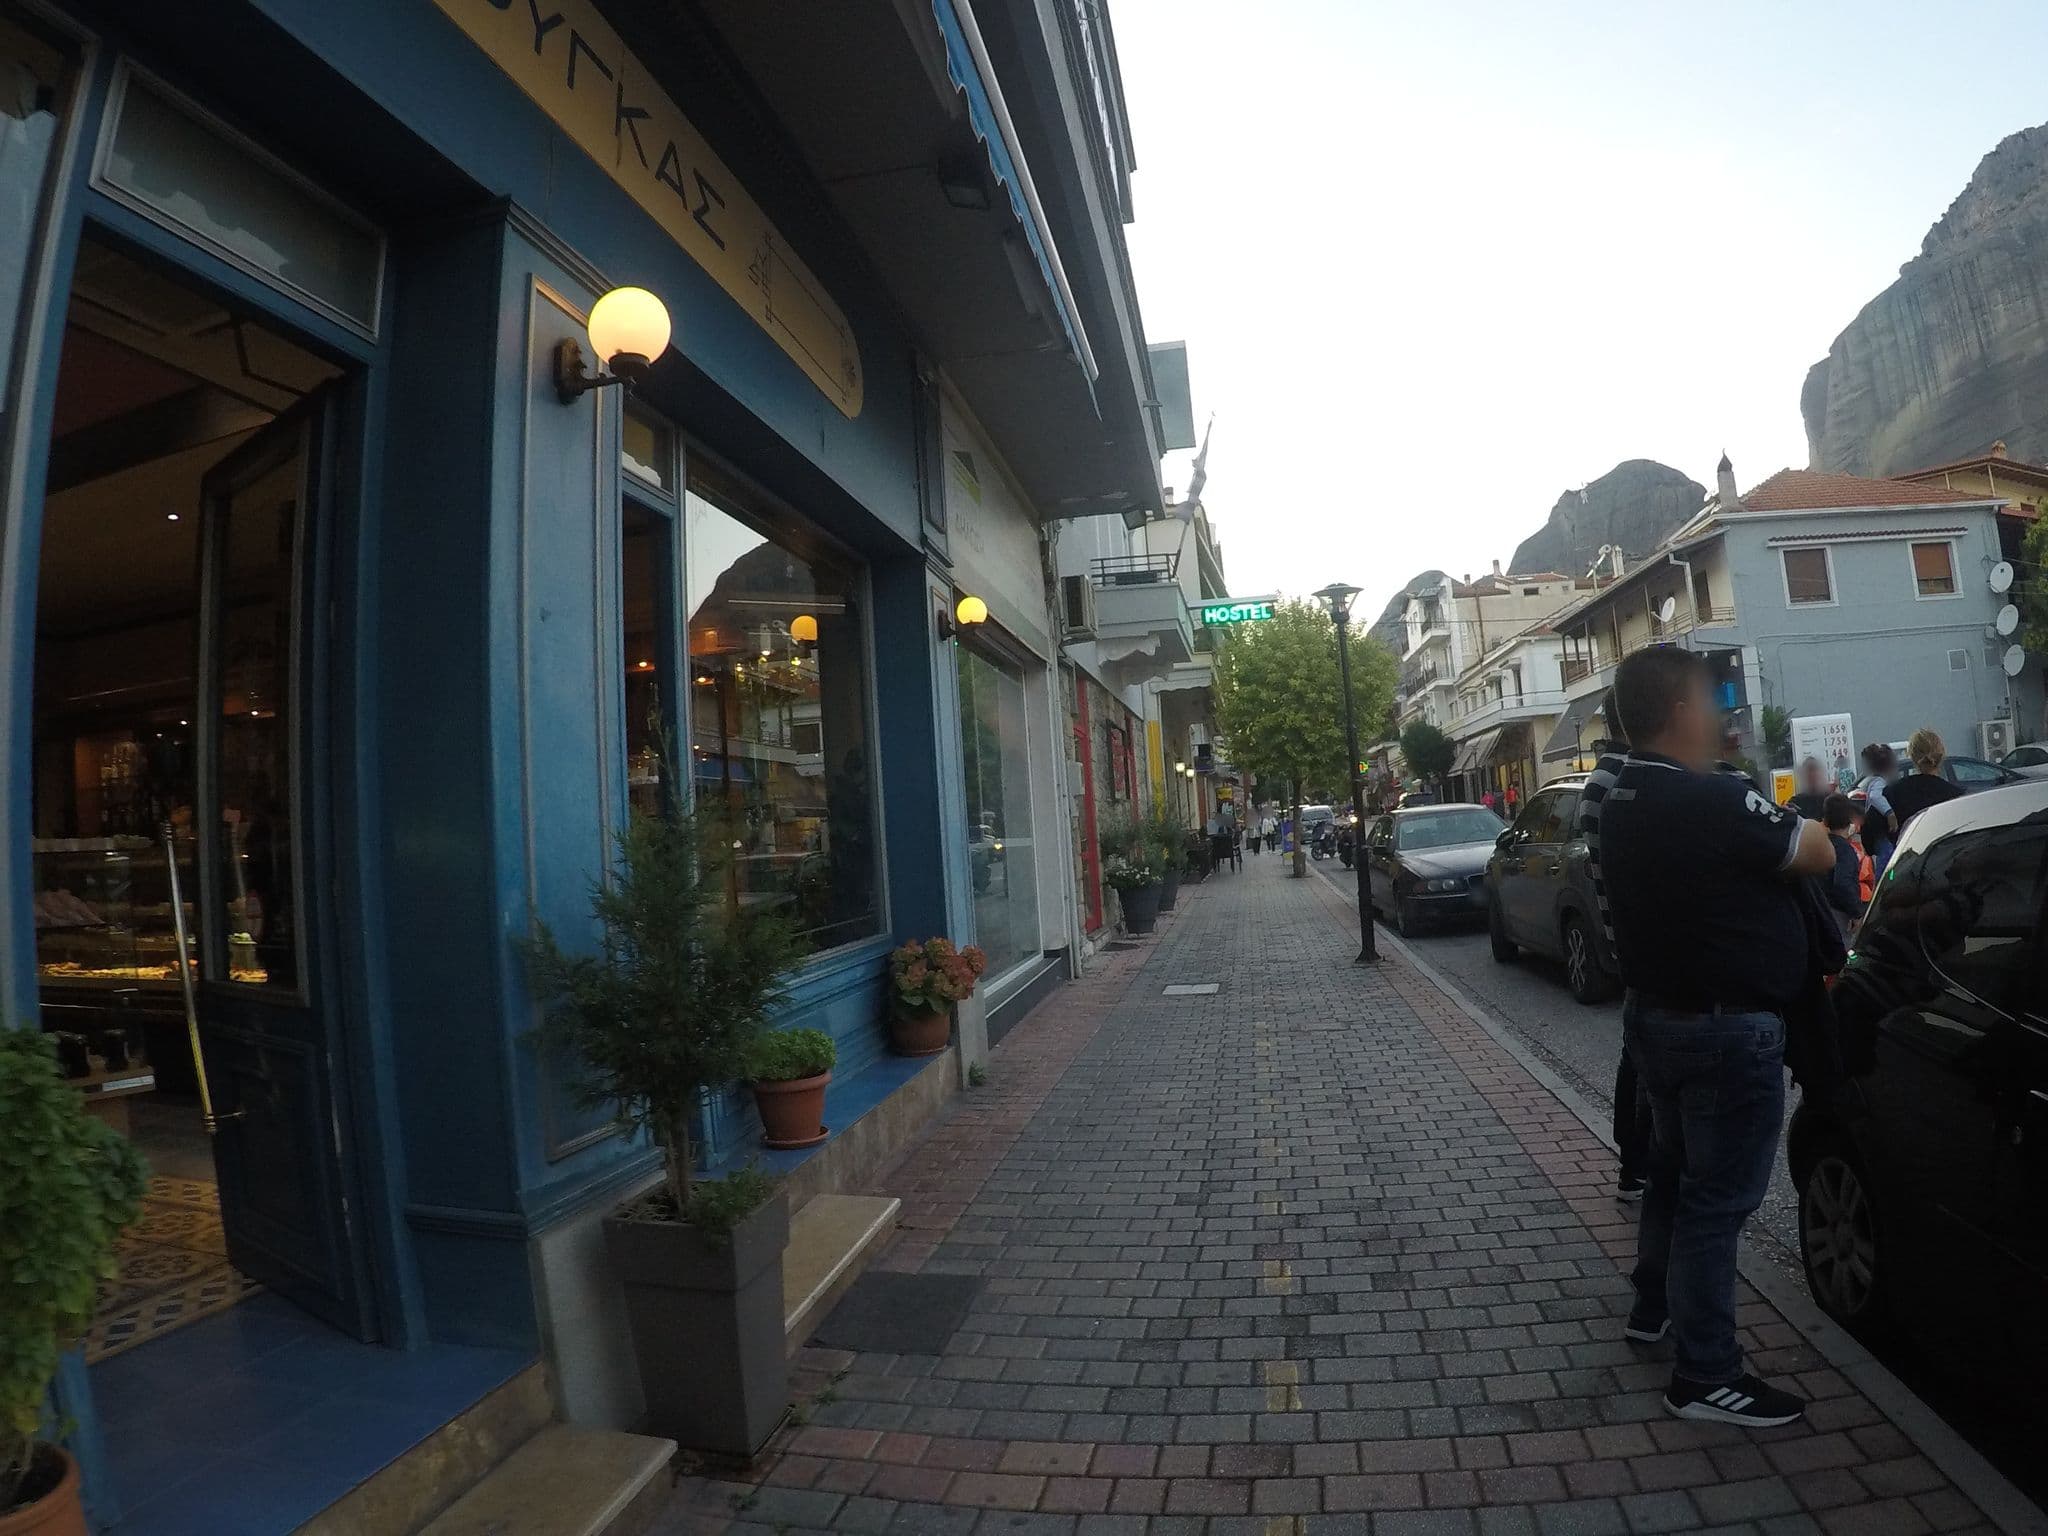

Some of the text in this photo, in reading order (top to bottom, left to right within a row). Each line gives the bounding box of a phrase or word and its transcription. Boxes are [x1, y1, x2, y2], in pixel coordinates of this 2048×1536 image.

[487, 0, 725, 250] ΥΓΚΑΣ
[1204, 603, 1272, 623] HOSTEL
[1822, 724, 1846, 735] 1.659
